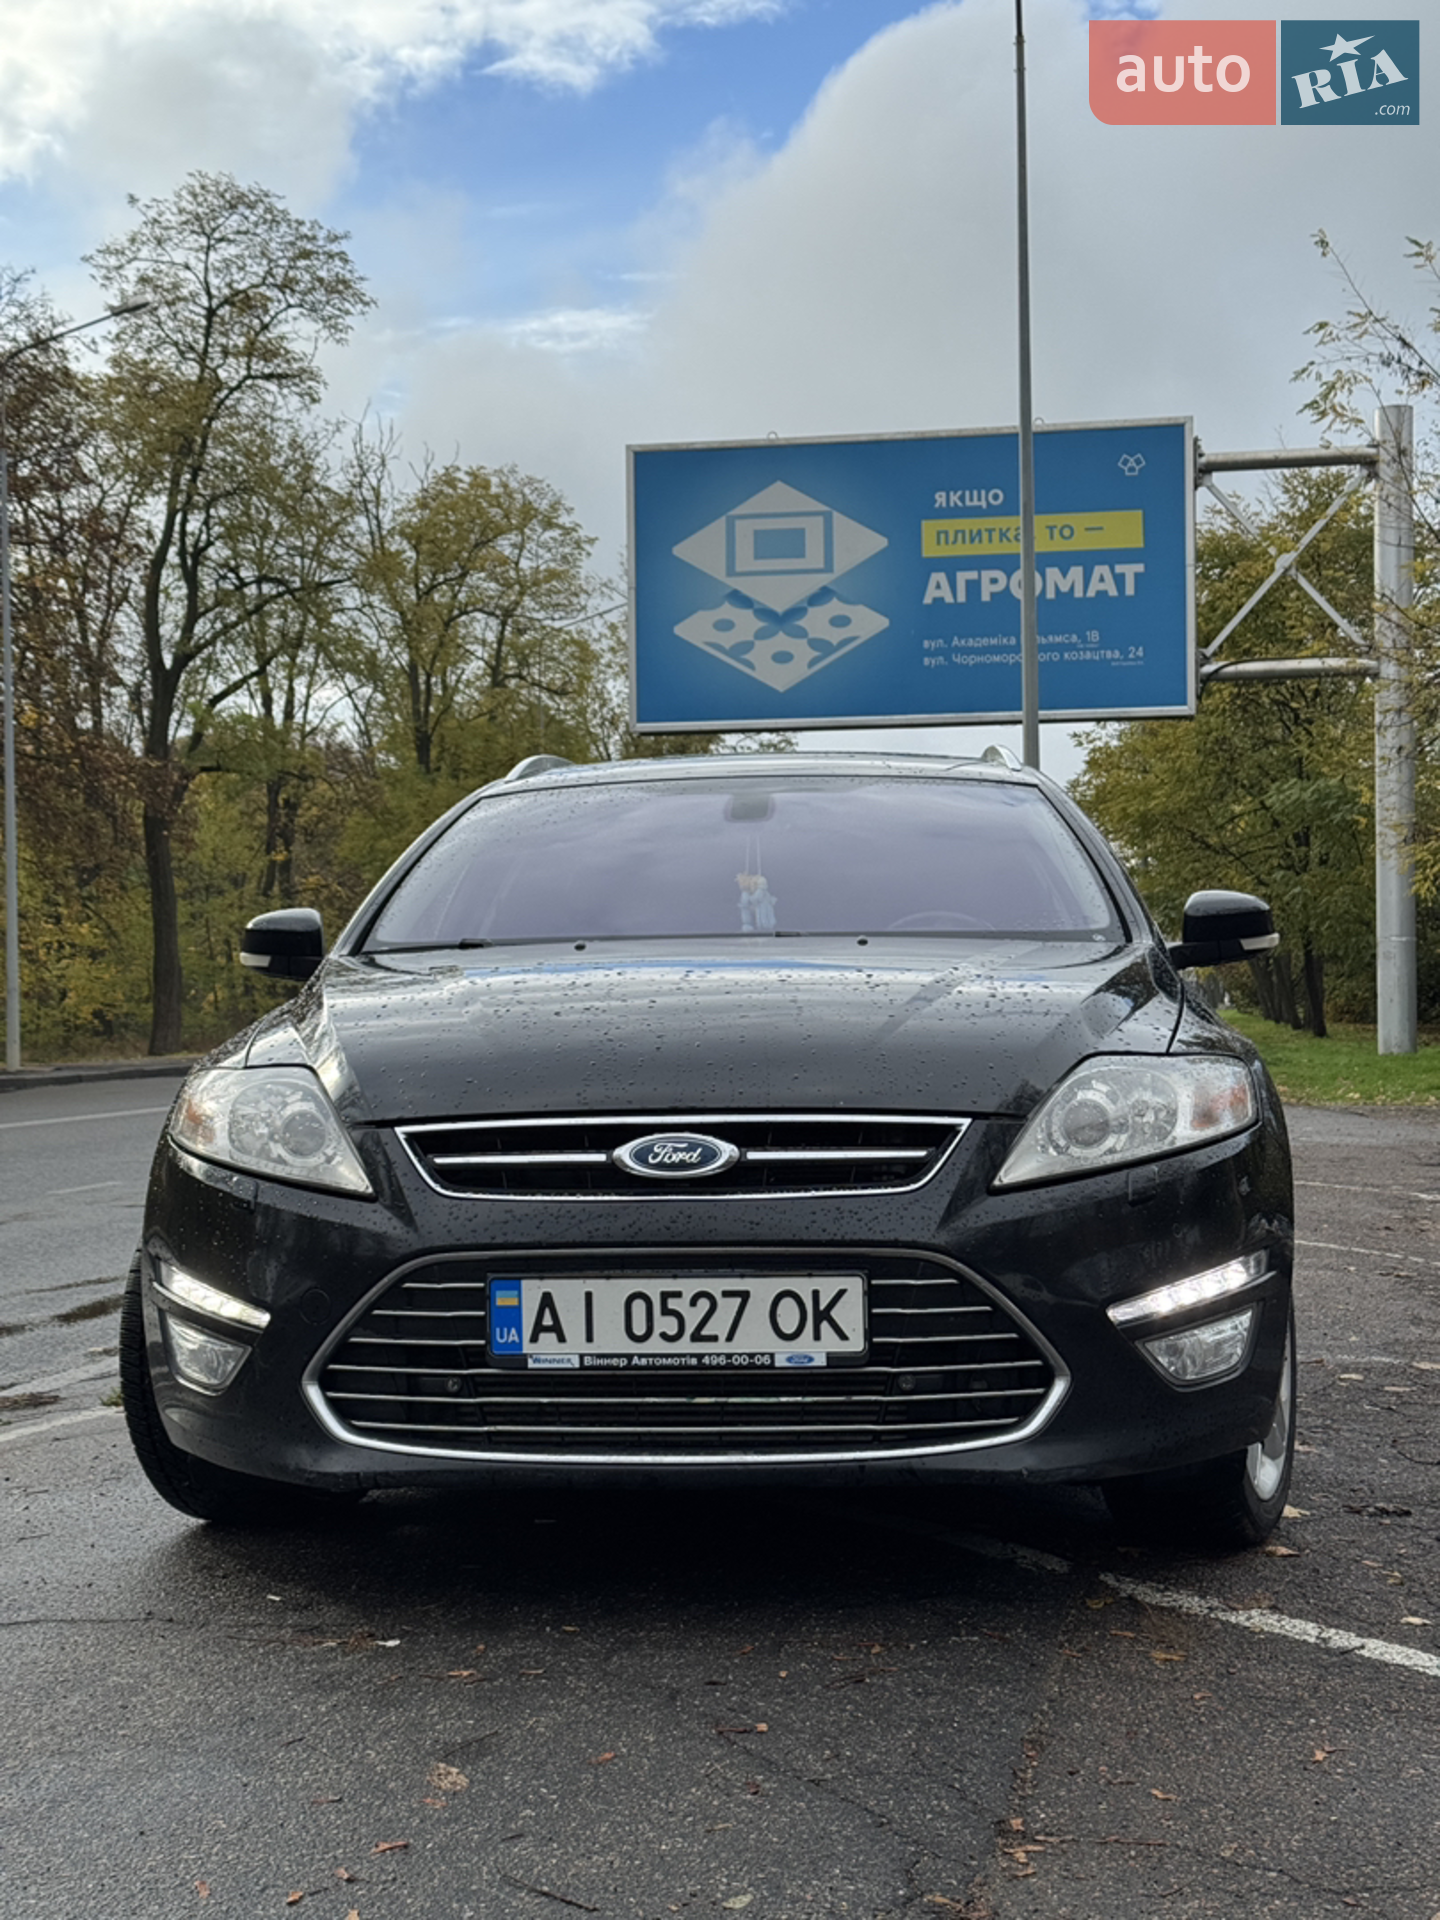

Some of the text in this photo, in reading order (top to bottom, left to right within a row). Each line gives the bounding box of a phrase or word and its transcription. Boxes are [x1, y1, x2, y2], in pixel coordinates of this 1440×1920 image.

[934, 488, 1004, 509] якщо
[936, 526, 1036, 546] плитка
[1045, 524, 1075, 541] то
[922, 563, 1145, 605] АГРОМАТ
[923, 638, 948, 651] вул.
[951, 634, 1017, 648] Академіка
[923, 645, 1144, 668] вул. Чорноморсого козацтва, 24
[648, 1142, 702, 1164] Ford
[529, 1288, 850, 1344] AI 0527 OK
[496, 1327, 520, 1344] UA
[583, 1354, 771, 1368] Віннер Автомотів 496-00-06
